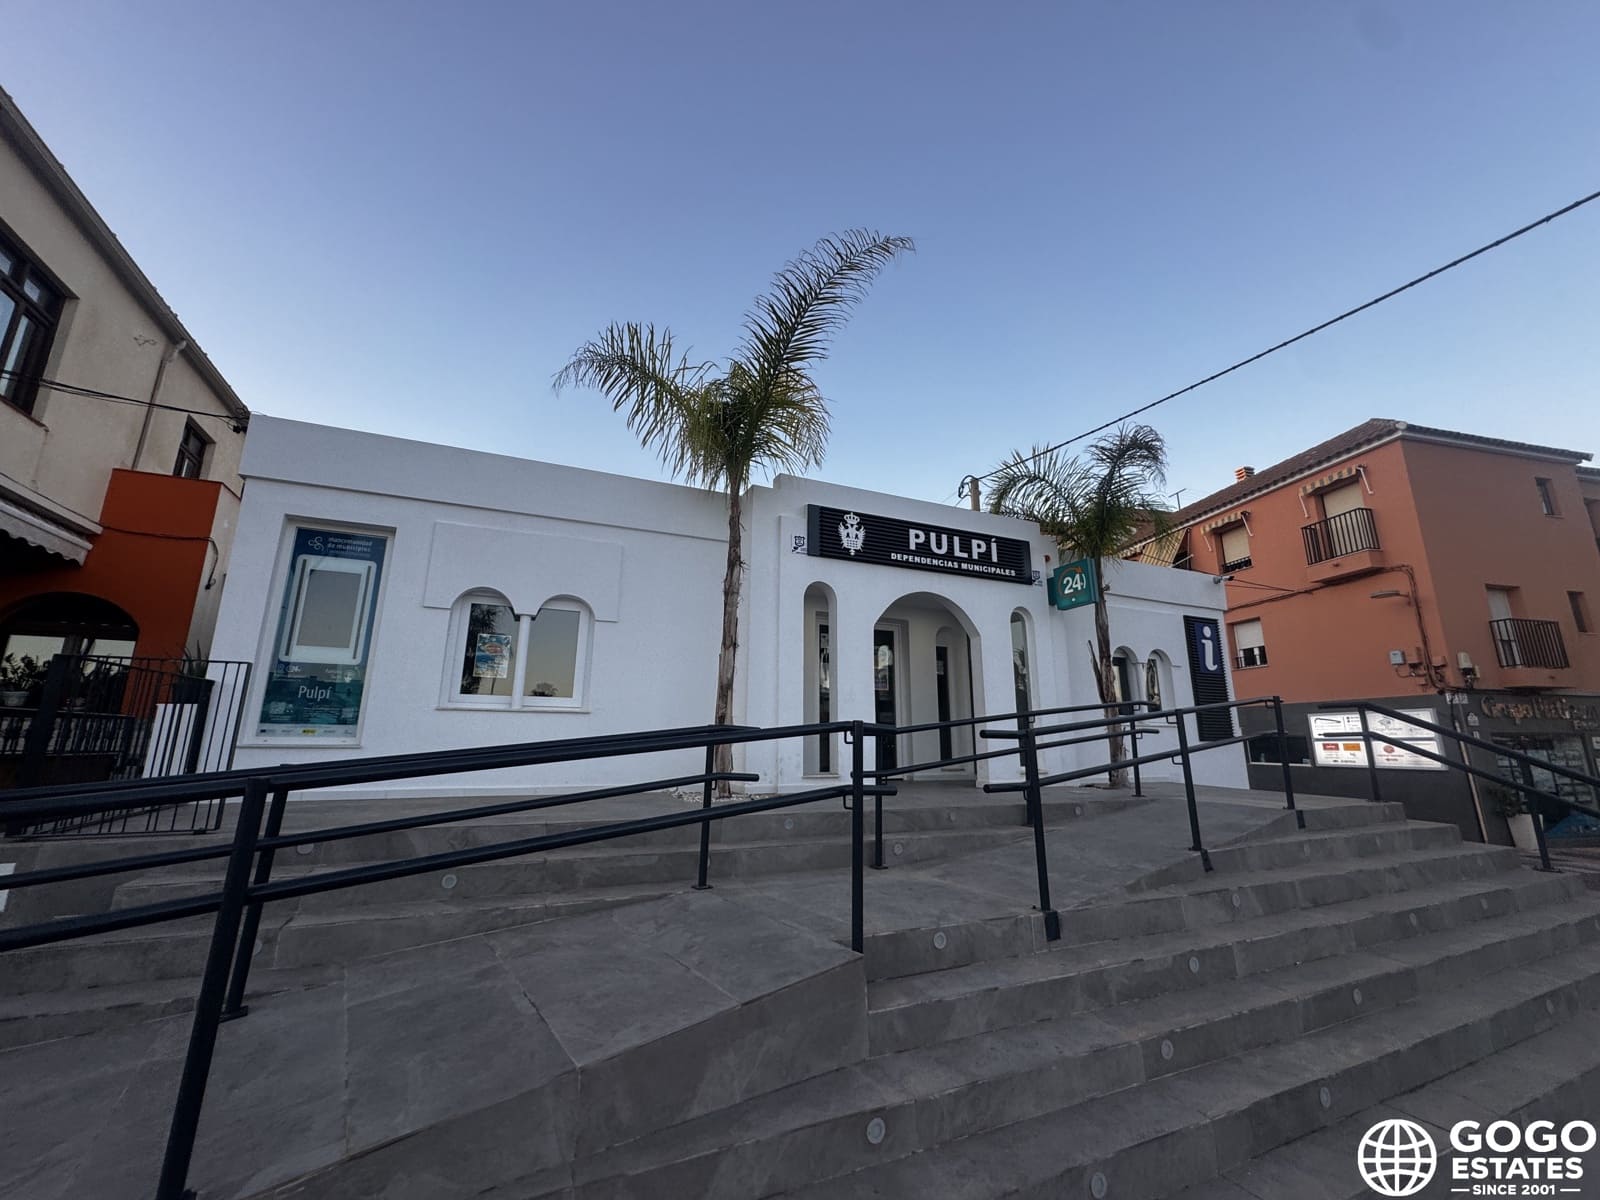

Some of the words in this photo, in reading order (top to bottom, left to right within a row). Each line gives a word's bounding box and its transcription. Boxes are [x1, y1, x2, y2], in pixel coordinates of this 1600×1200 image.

[909, 529, 998, 562] PULPÍ
[891, 553, 959, 569] DEPENDENCIAS
[961, 563, 1016, 577] MUNICIPALES
[1201, 626, 1218, 670] i
[298, 685, 332, 702] Pulpí
